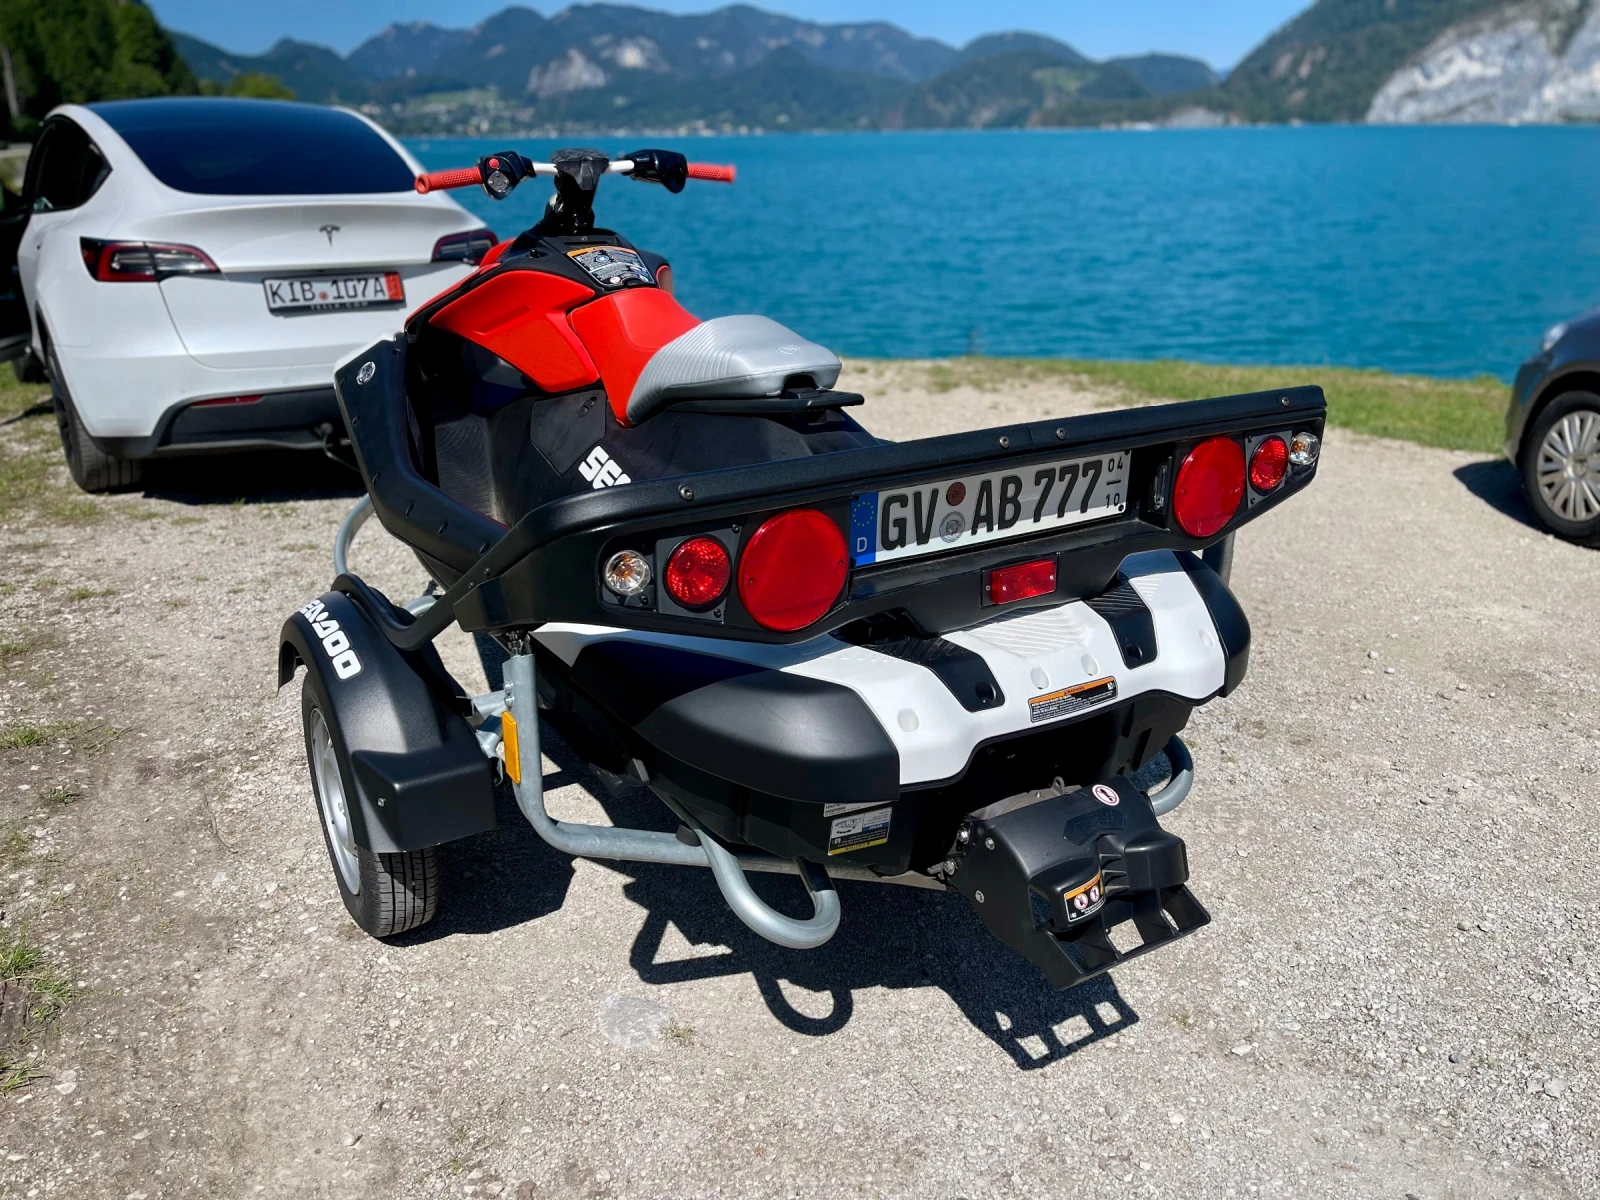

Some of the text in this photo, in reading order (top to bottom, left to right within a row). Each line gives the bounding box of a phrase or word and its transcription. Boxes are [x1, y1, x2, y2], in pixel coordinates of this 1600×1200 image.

[269, 281, 315, 304] KIB
[1107, 456, 1124, 473] 04
[857, 537, 868, 553] D
[880, 488, 939, 551] GV
[970, 475, 1022, 536] AB
[1032, 459, 1103, 523] 777
[1105, 492, 1120, 508] 10
